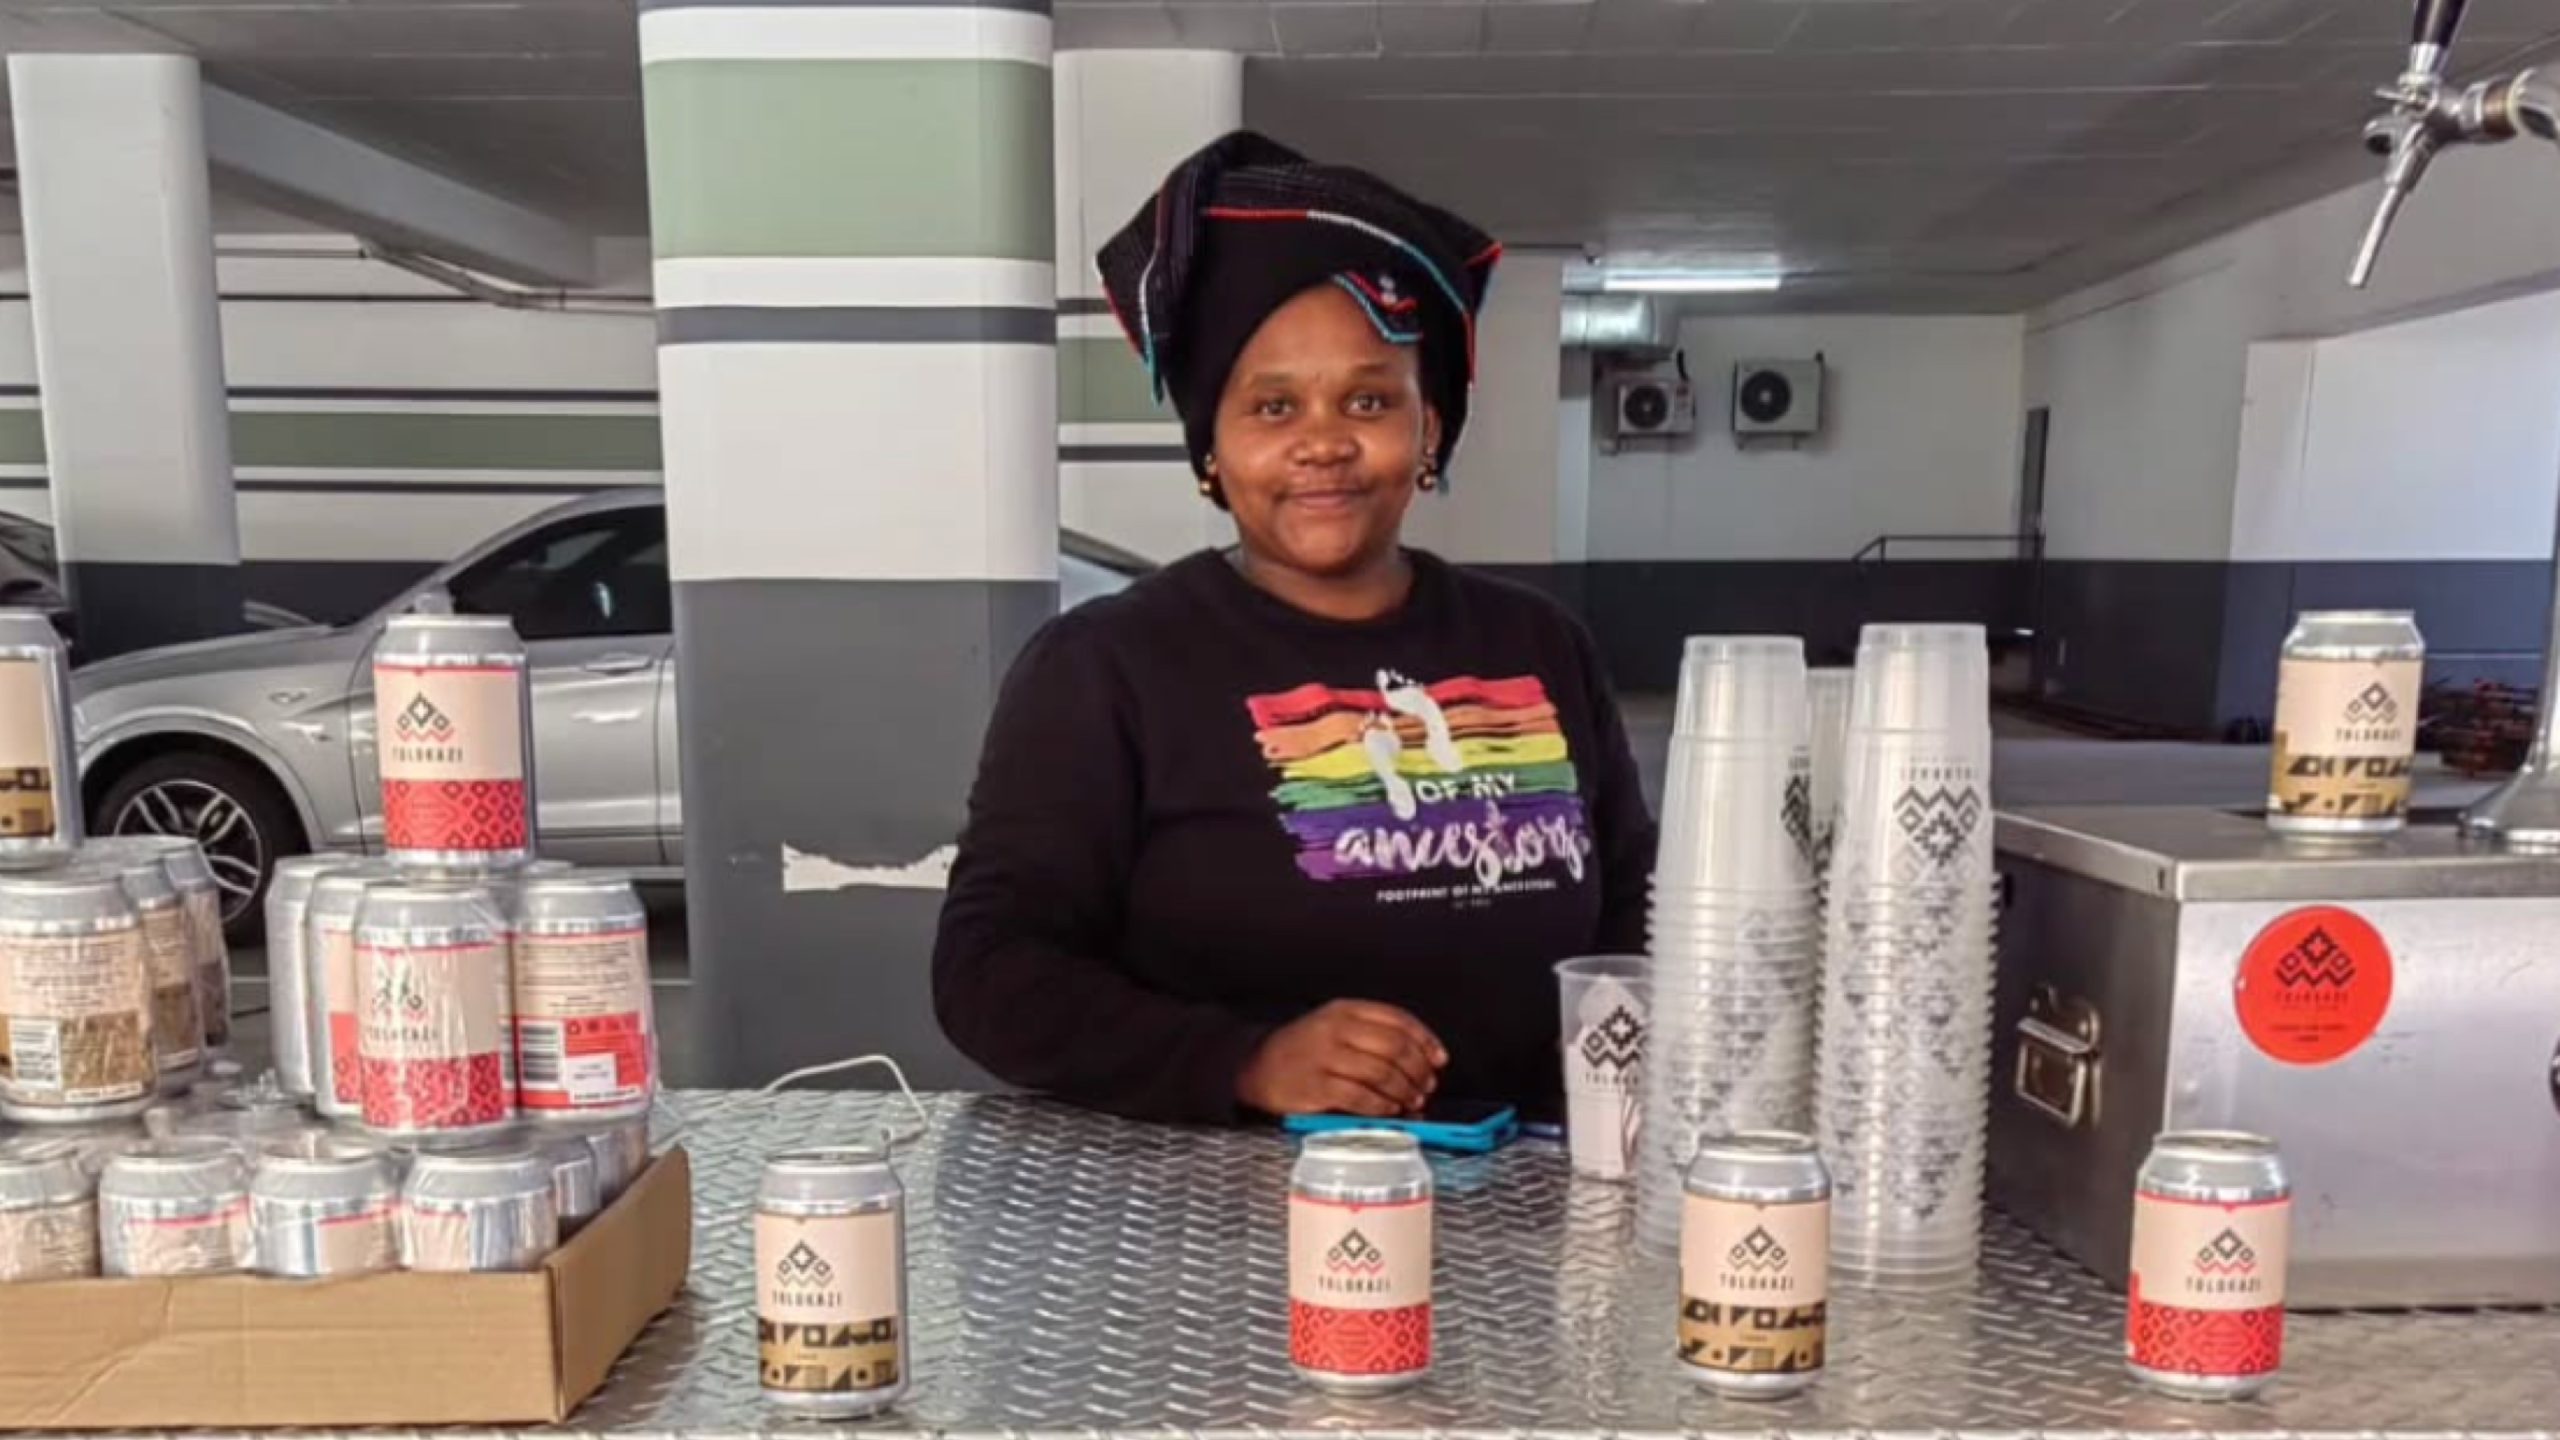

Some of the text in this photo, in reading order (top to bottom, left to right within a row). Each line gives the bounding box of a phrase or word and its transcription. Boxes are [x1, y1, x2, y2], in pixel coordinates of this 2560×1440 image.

[391, 744, 464, 763] TOLOKAZI
[1415, 773, 1516, 803] OF MY
[1317, 1274, 1391, 1294] TOLOKAZI
[1719, 1271, 1795, 1292] TOLOKAZI
[2185, 1275, 2261, 1294] TOLOKAZI
[771, 1289, 844, 1308] TOLOKAZI
